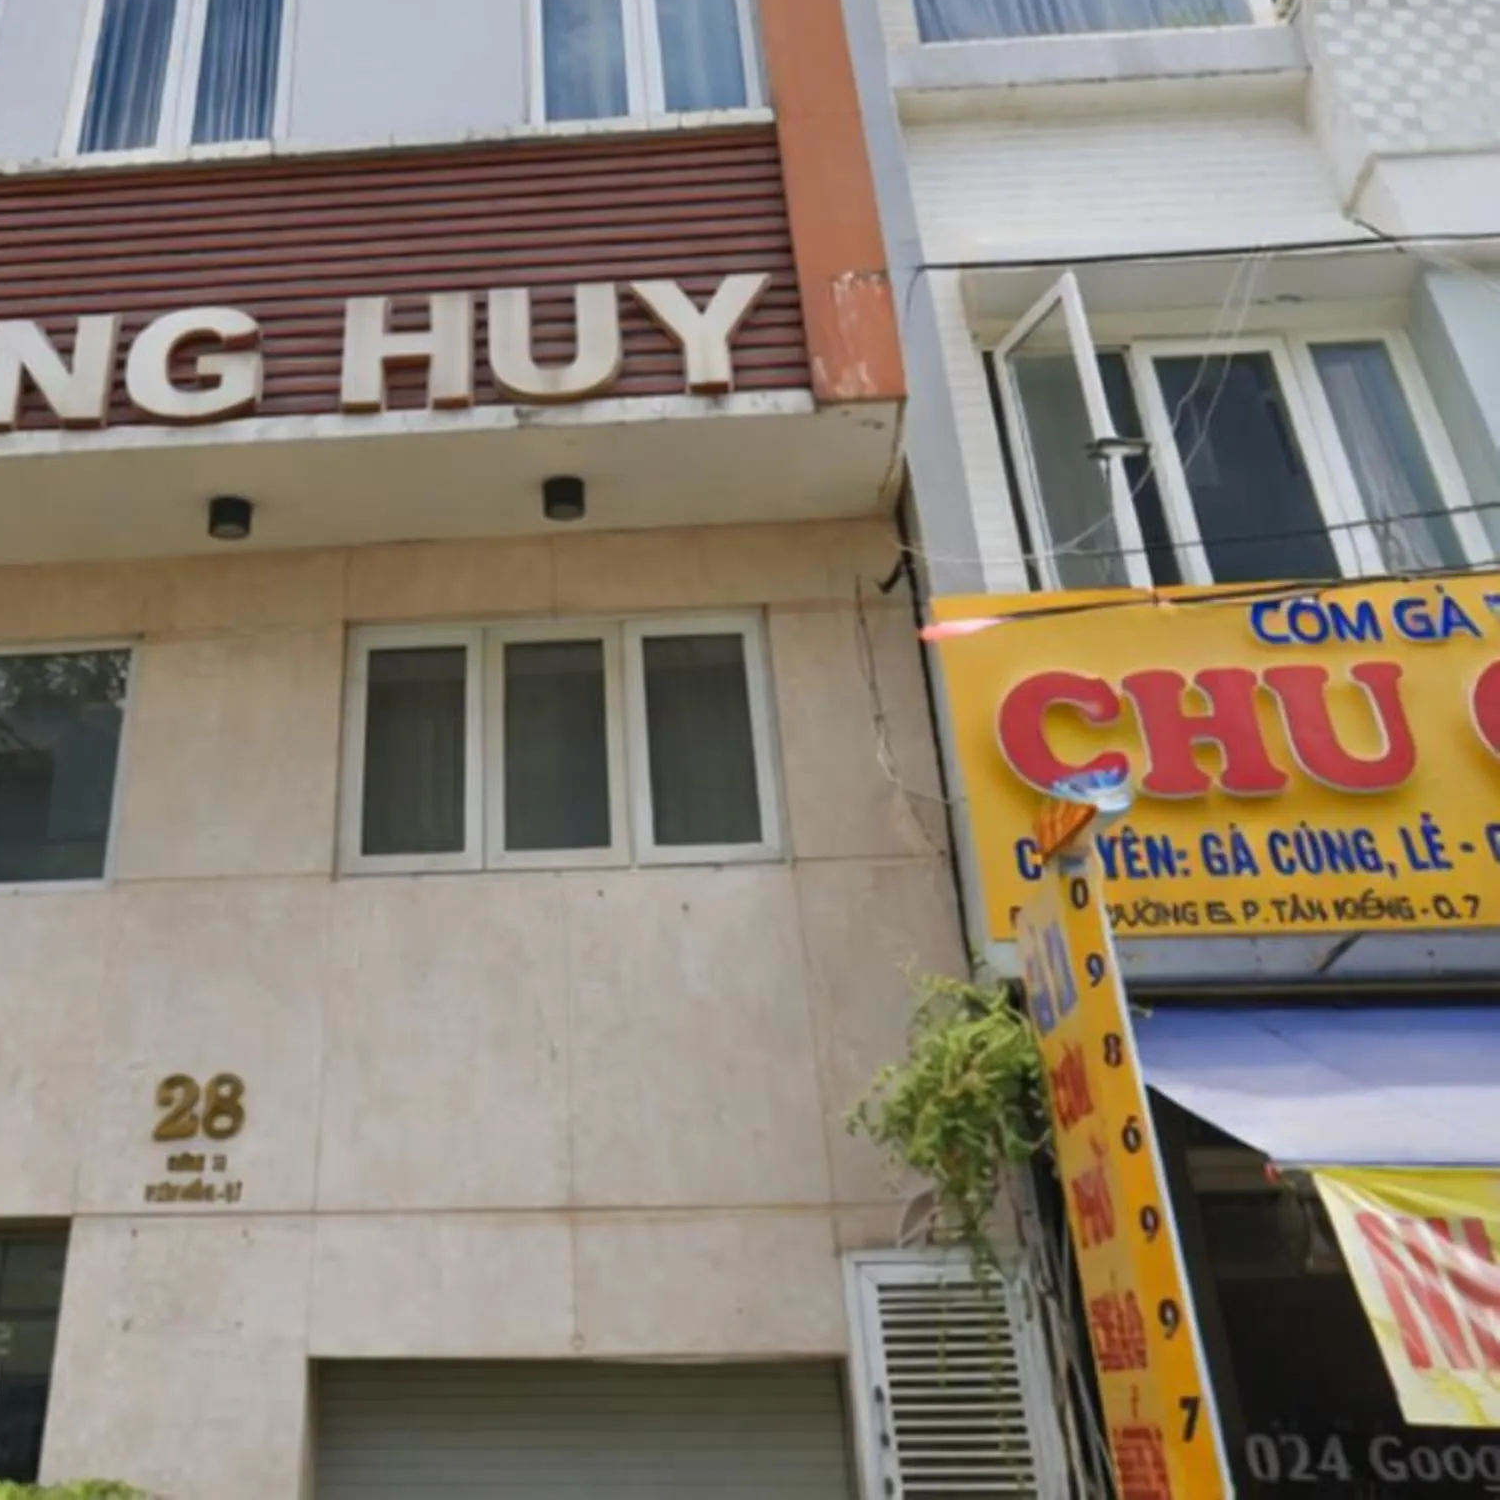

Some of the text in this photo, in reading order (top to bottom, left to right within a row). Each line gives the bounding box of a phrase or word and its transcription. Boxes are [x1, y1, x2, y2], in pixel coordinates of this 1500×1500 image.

[340, 273, 771, 414] HUY
[1016, 825, 1190, 880] CYÊN:
[152, 1072, 246, 1143] 28
